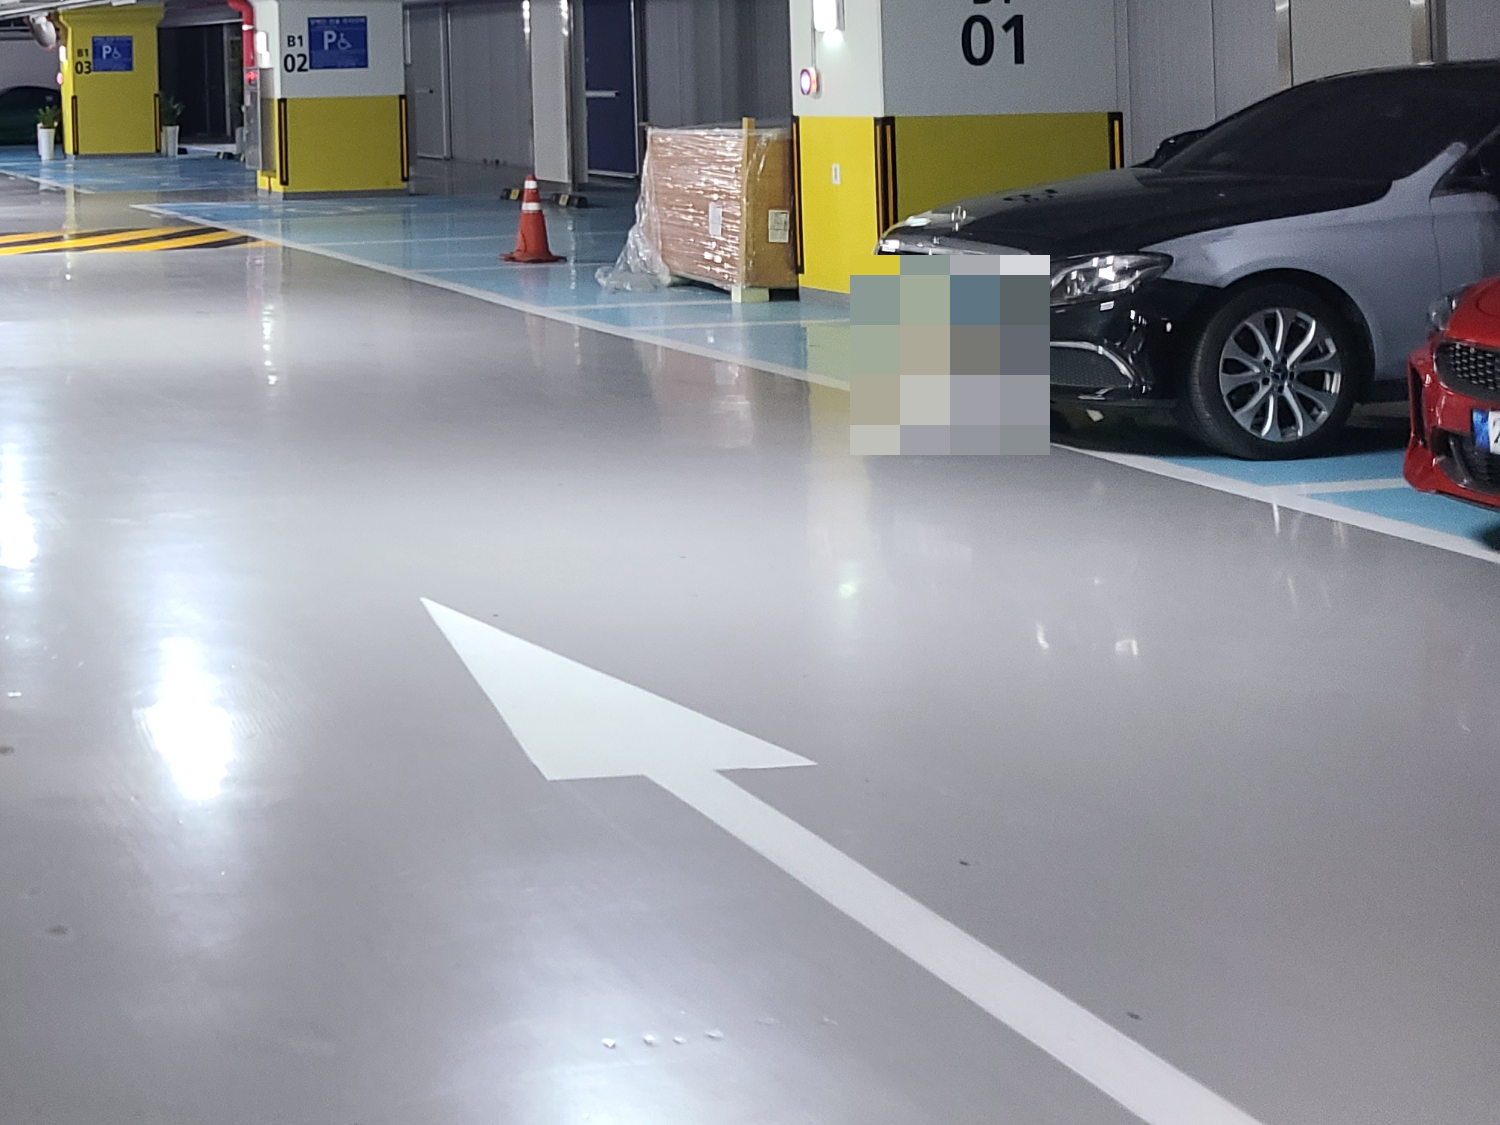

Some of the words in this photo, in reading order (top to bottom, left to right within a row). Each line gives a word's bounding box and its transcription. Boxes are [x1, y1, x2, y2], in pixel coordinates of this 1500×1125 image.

[287, 35, 304, 48] B1
[323, 30, 337, 51] P
[961, 14, 1024, 66] 01
[77, 48, 89, 57] B1
[102, 45, 112, 60] P
[75, 61, 92, 75] 03
[283, 53, 309, 73] 02
